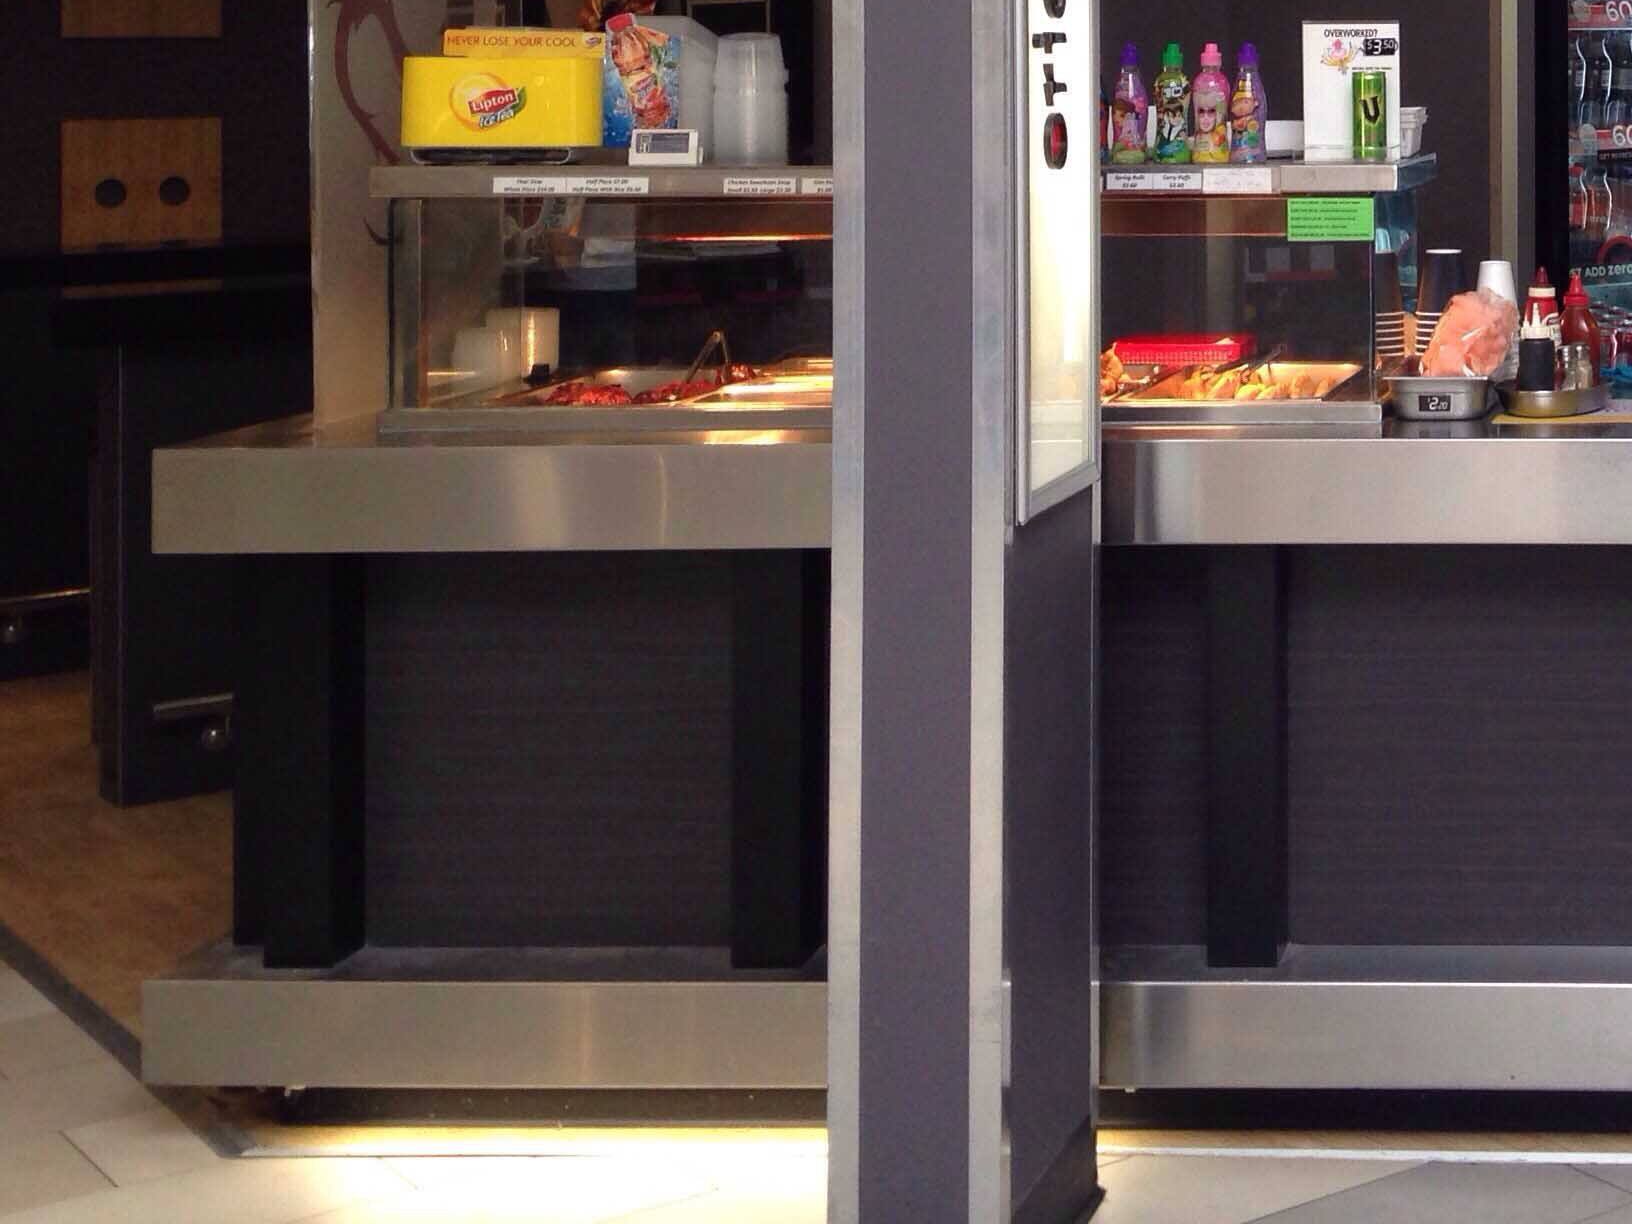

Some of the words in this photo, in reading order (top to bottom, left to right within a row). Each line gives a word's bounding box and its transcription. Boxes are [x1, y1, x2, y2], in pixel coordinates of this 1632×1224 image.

[447, 34, 480, 47] NEVER
[483, 35, 509, 46] LOSE
[512, 35, 543, 47] YOUR
[546, 35, 577, 47] COOL
[1366, 39, 1395, 55] $3.50
[470, 92, 517, 113] Lipton
[1585, 266, 1606, 278] ADD
